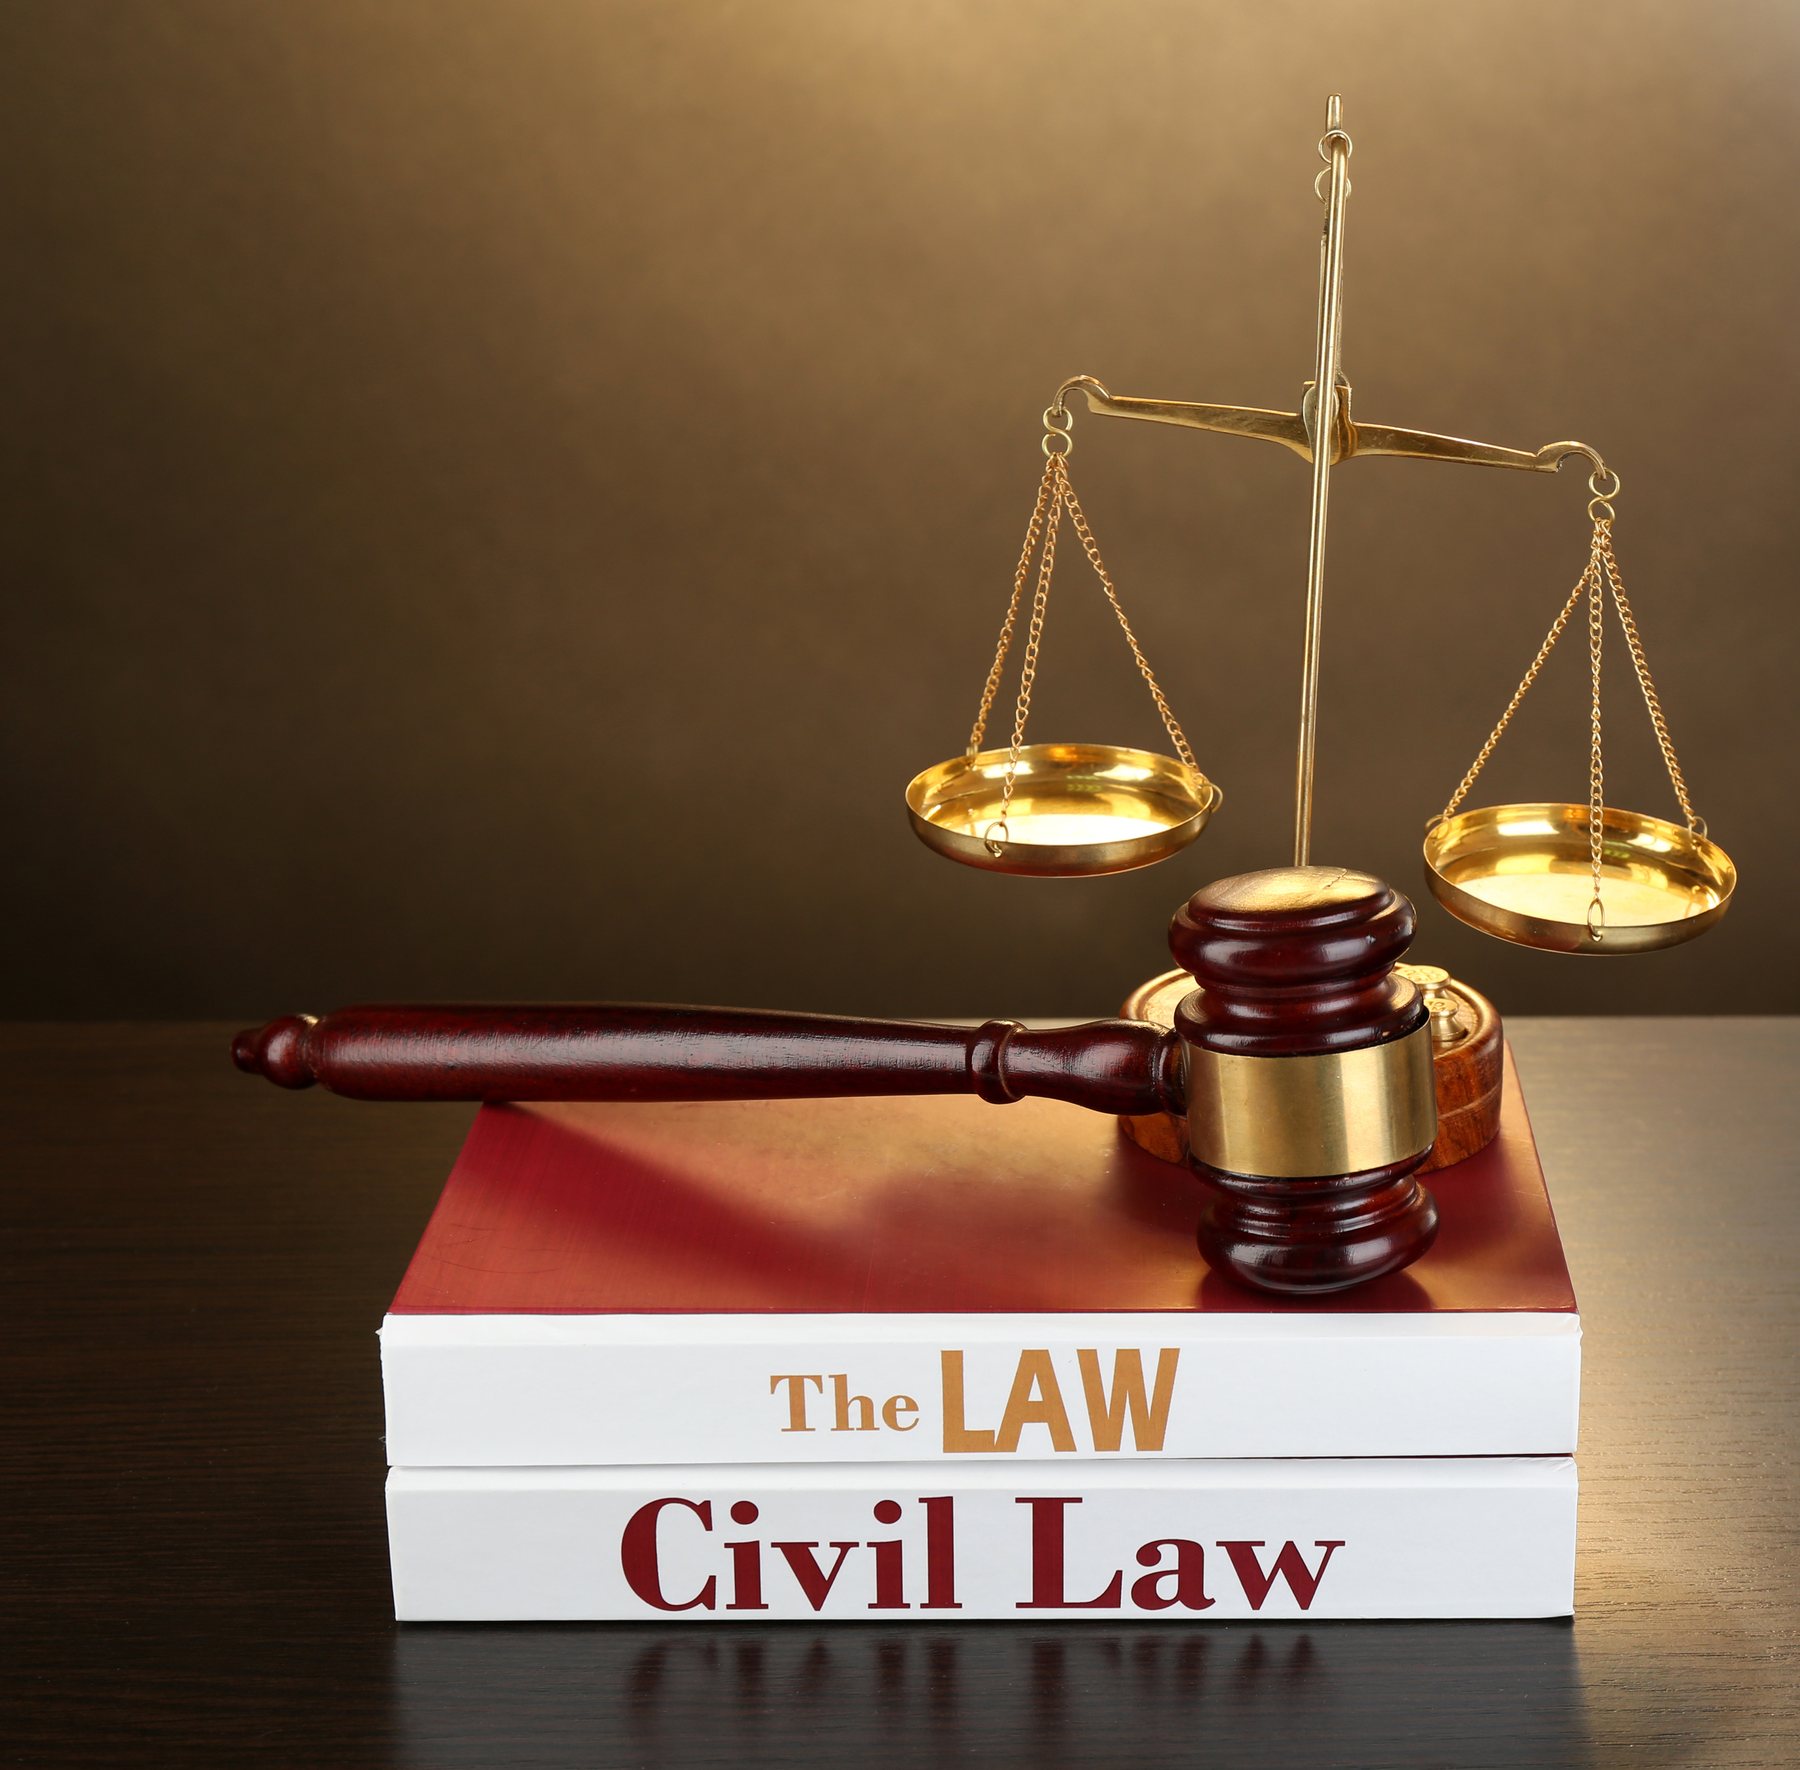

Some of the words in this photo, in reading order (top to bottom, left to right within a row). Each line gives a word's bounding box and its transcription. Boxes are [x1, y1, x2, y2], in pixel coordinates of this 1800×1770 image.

[770, 1374, 920, 1432] The
[942, 1347, 1180, 1452] LAW
[621, 1496, 962, 1612] Civil
[1015, 1497, 1346, 1611] Law
